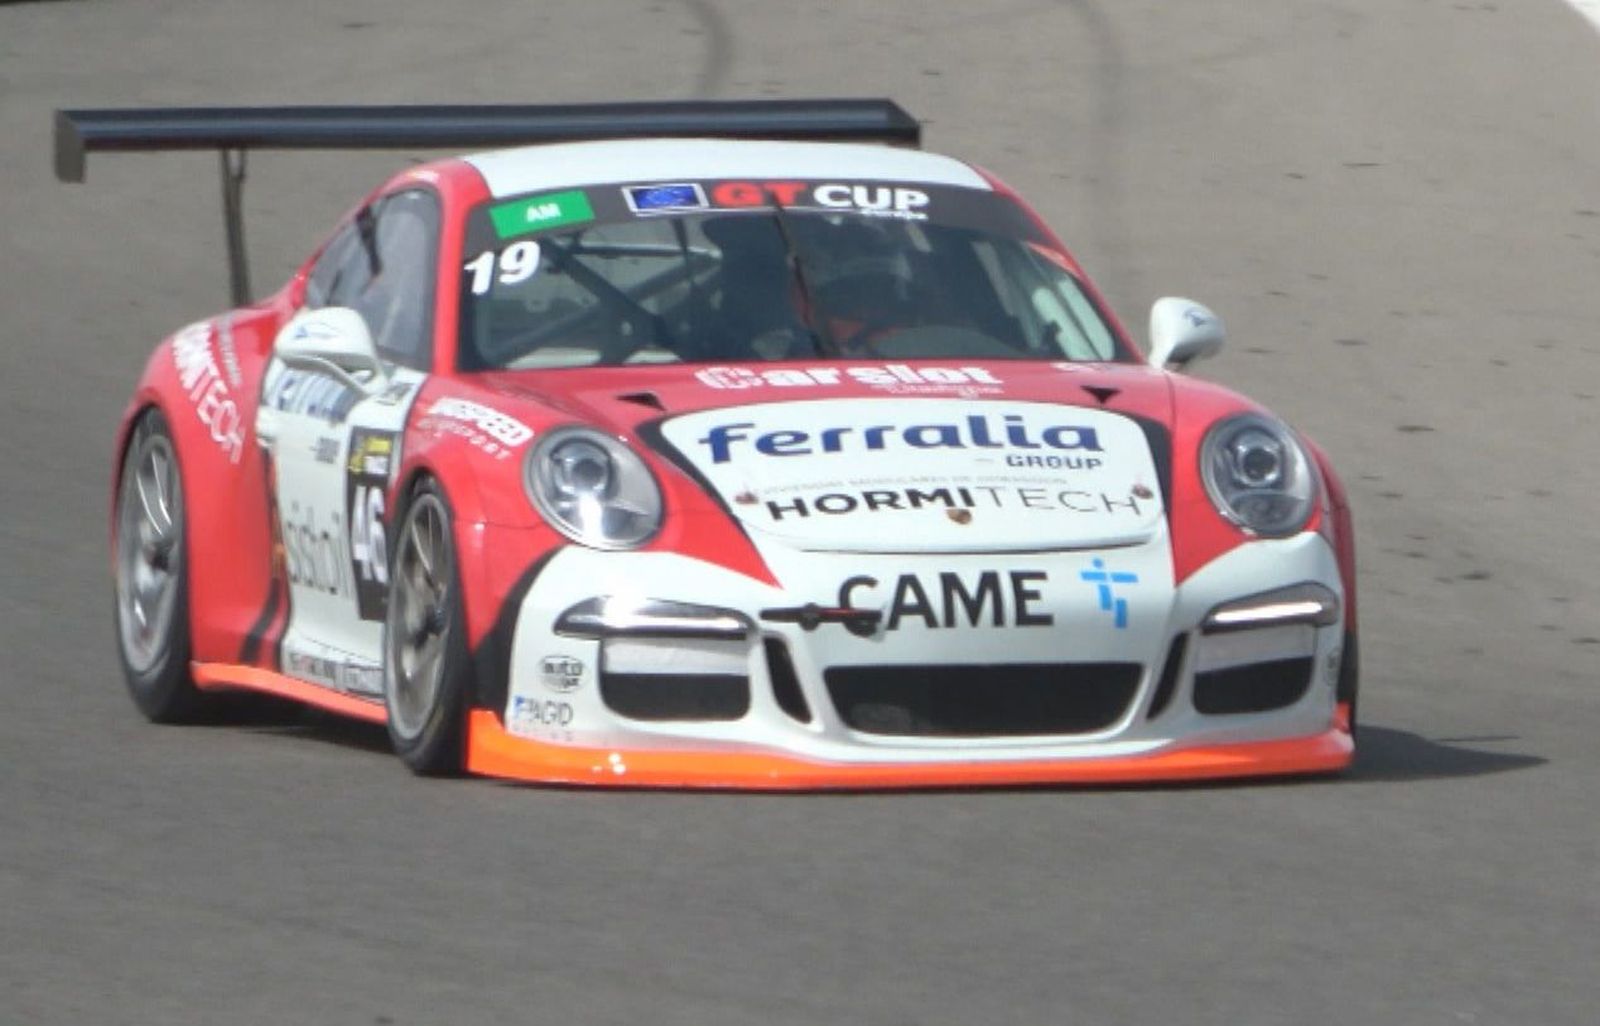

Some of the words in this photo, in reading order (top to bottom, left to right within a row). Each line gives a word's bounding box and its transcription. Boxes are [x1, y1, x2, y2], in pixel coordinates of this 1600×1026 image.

[526, 202, 562, 223] AM
[711, 181, 807, 208] GT
[813, 184, 931, 212] CUP
[463, 240, 542, 297] 19
[698, 414, 1105, 465] ferralia
[1005, 454, 1105, 470] GROUP
[766, 484, 1142, 522] HORMITECH
[837, 568, 1055, 638] CAME
